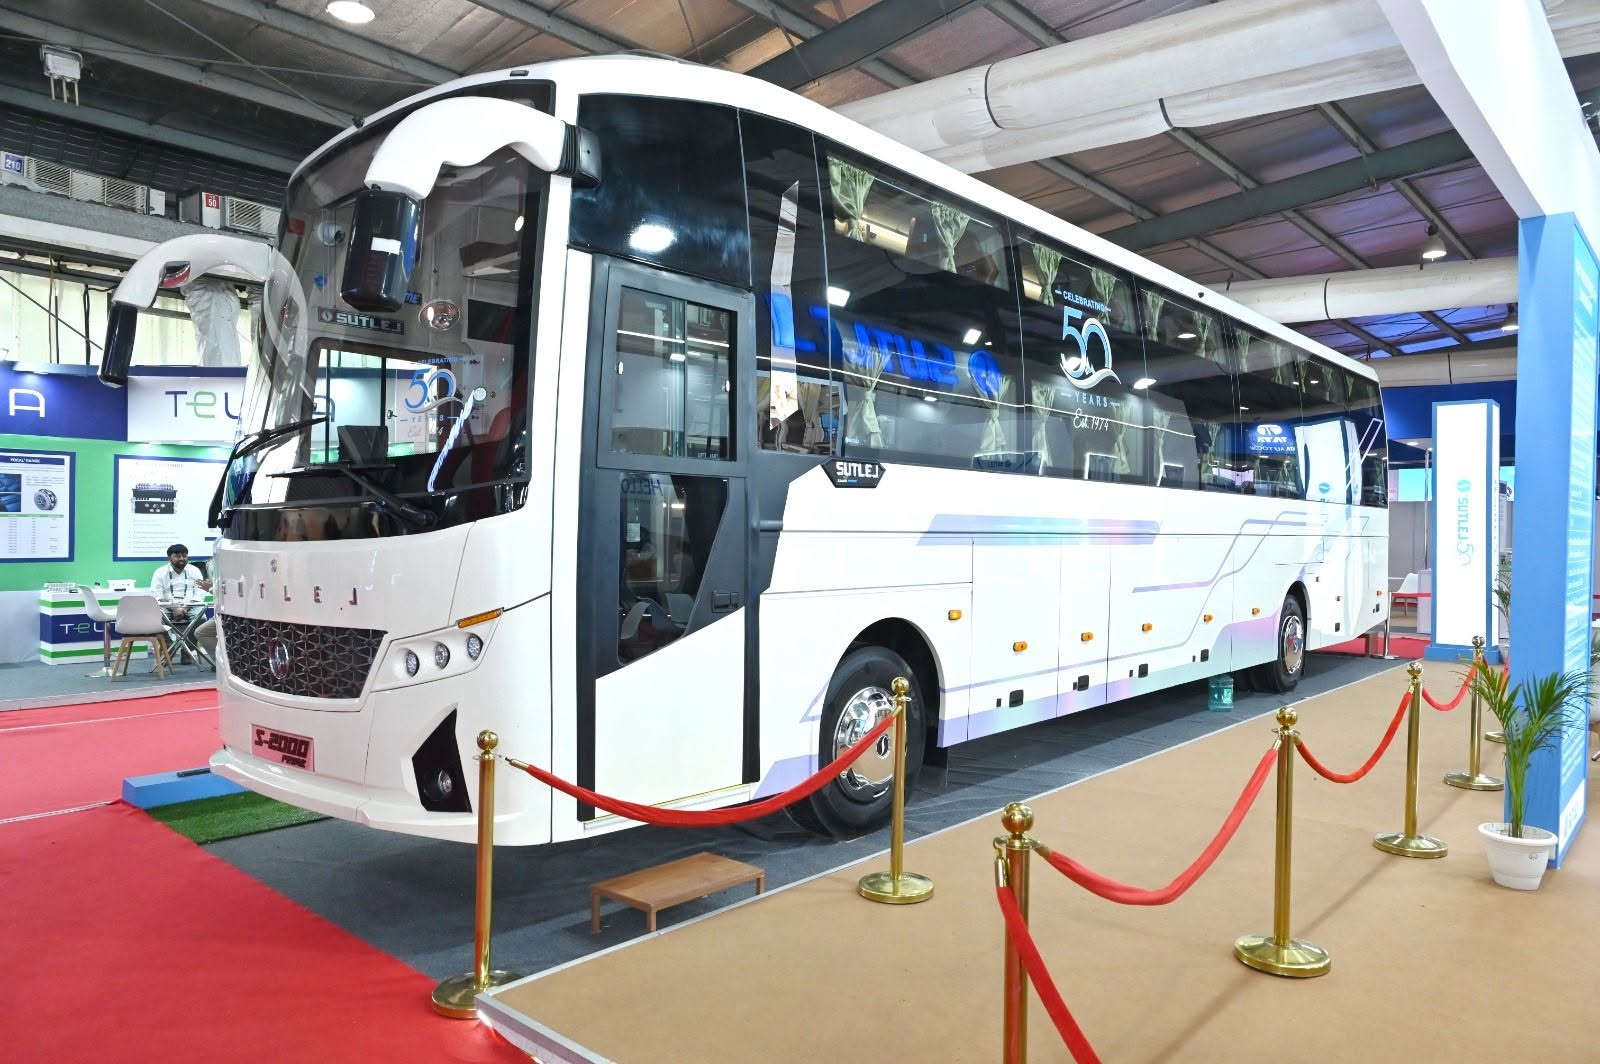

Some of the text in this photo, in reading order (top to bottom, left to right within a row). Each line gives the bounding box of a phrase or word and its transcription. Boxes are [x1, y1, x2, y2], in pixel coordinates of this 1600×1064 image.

[6, 159, 21, 171] 210
[1063, 290, 1107, 312] CELEBRATING
[336, 313, 400, 333] SUTLEJ
[1060, 305, 1114, 379] 50
[405, 368, 457, 410] 50
[1075, 391, 1108, 408] YEARS
[836, 461, 879, 478] SUTLEJ
[1457, 497, 1469, 541] SUTLEJ
[254, 729, 310, 758] S-2000
